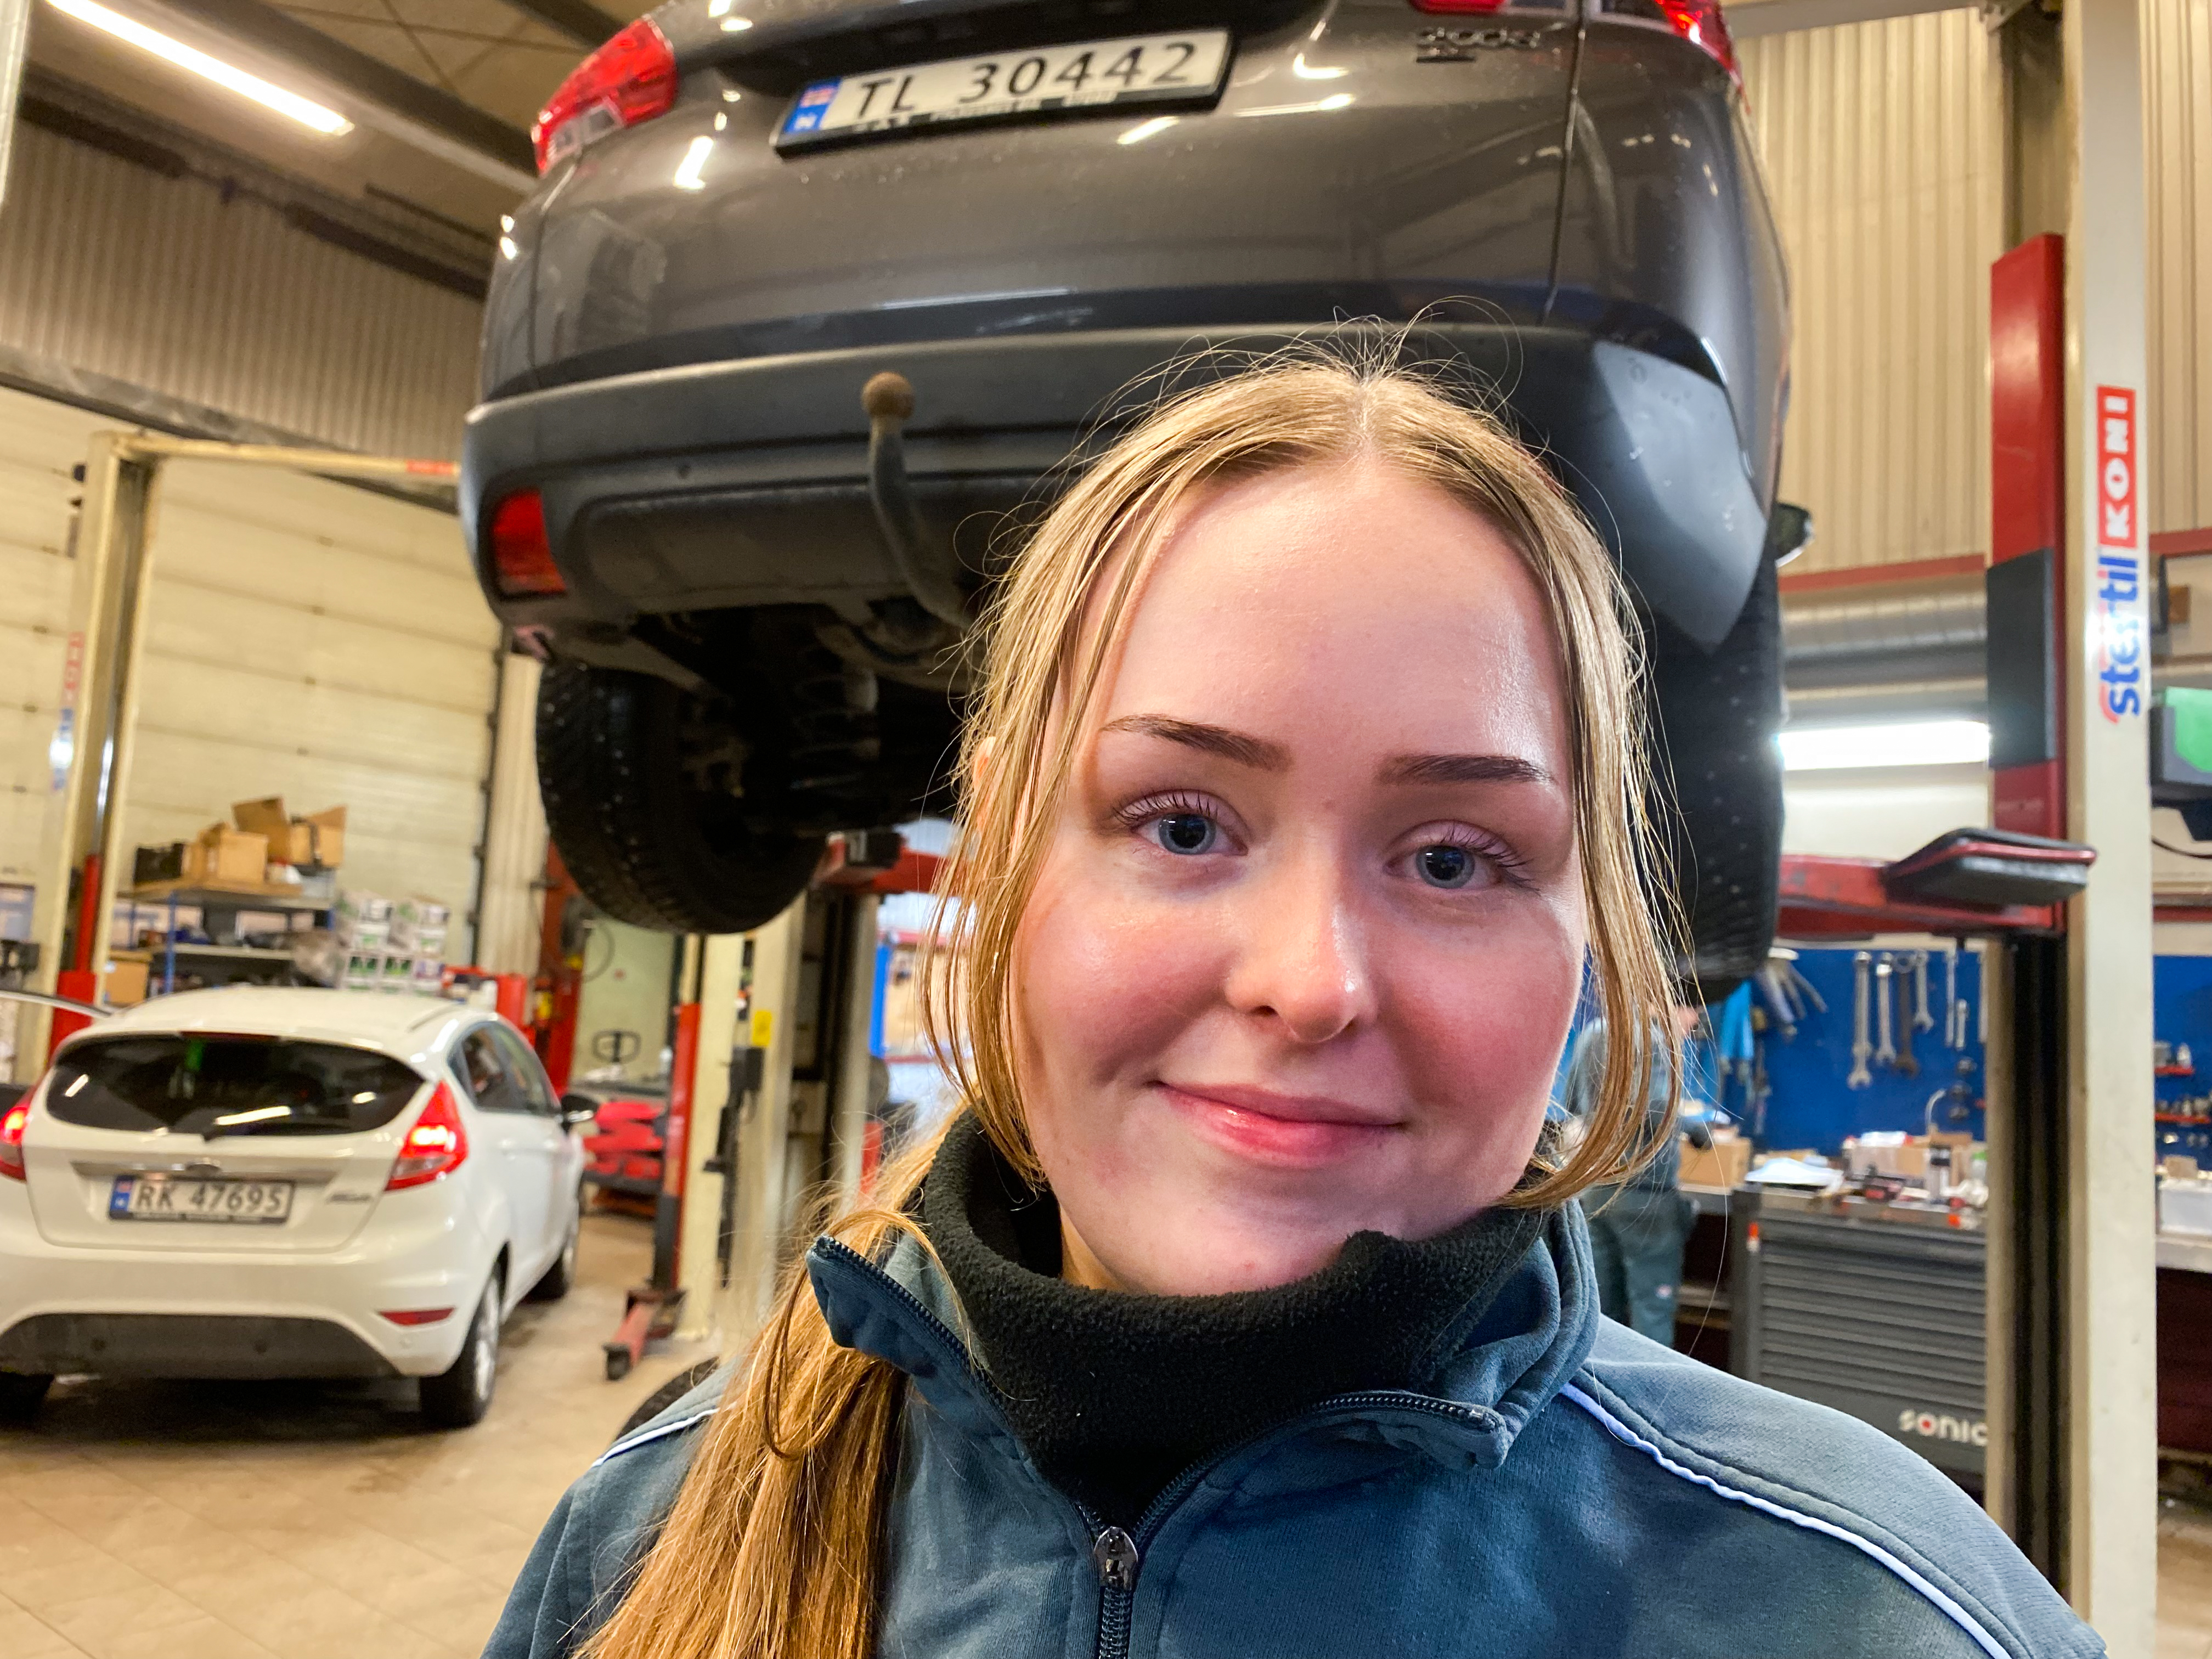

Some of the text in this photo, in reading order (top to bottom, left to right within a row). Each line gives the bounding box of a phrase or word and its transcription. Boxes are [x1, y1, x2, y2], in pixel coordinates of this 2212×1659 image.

[858, 75, 916, 119] TL
[958, 41, 1197, 103] 30442
[2104, 395, 2130, 540] KONI
[137, 1182, 283, 1213] RK 47695
[1899, 1409, 1989, 1446] sonic
